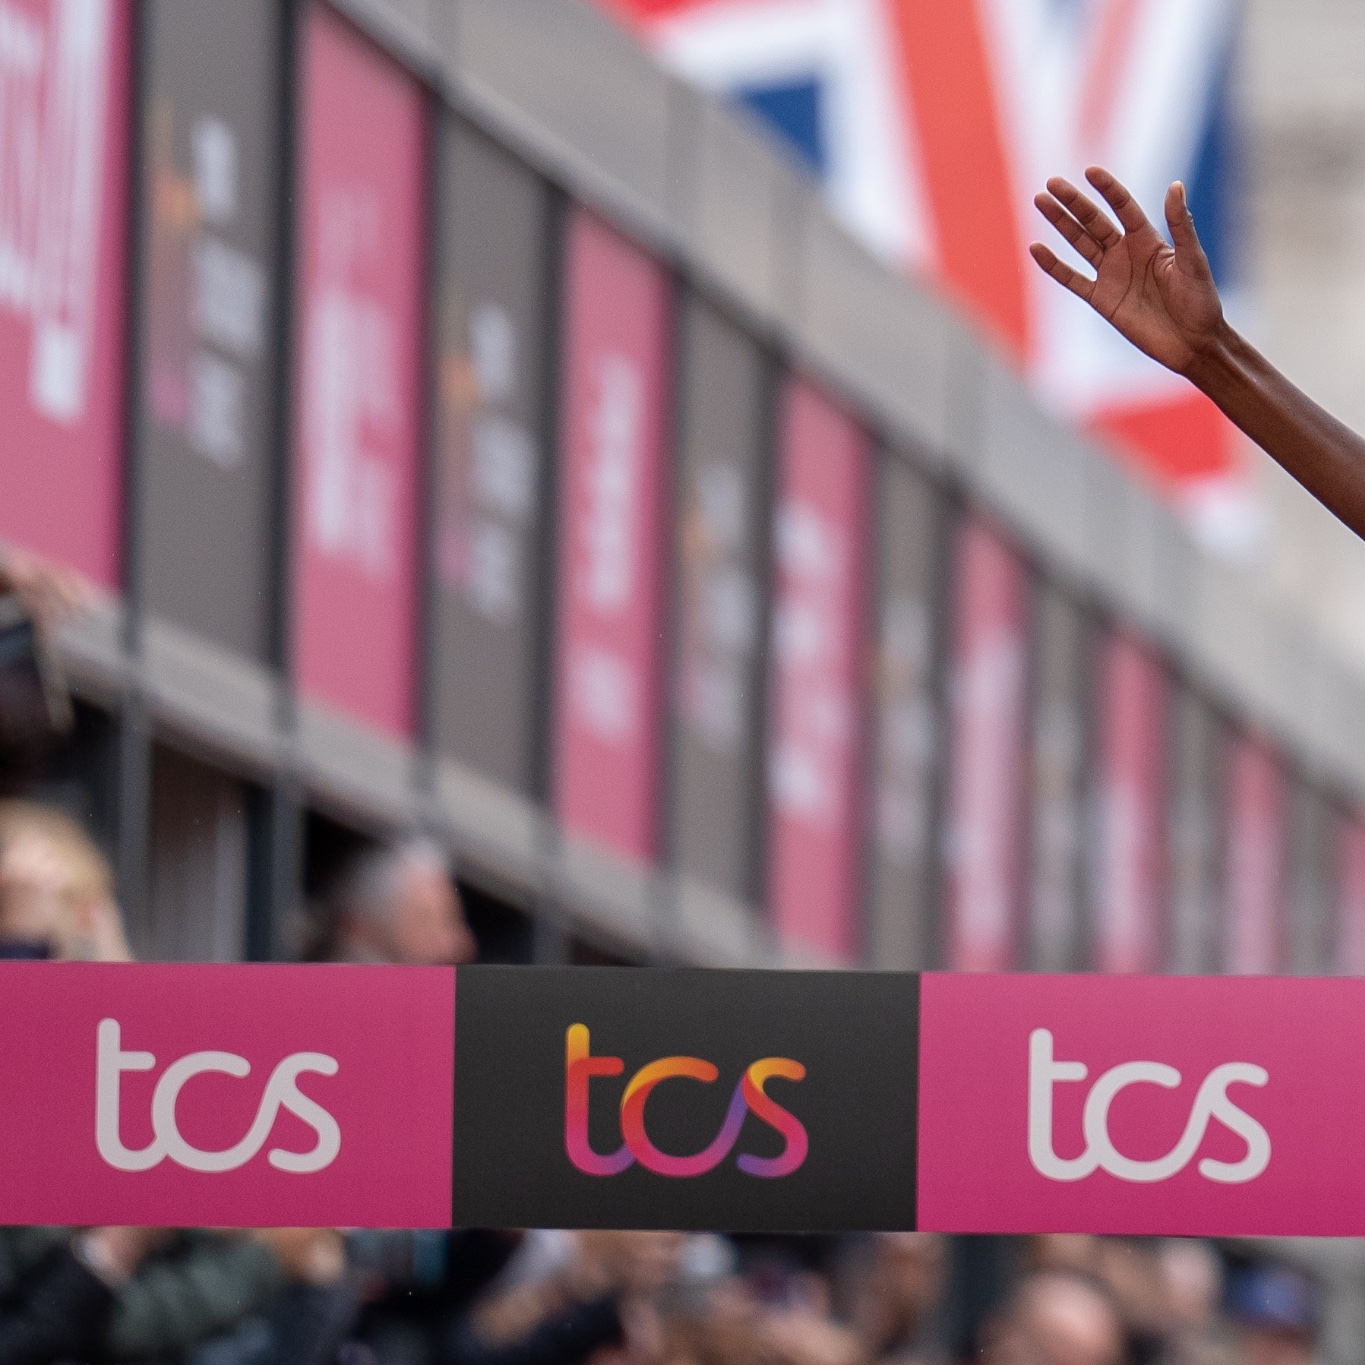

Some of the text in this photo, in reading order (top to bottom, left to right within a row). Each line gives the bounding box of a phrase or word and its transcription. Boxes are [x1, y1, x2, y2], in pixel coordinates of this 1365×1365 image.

[95, 1018, 342, 1173] tcs
[564, 1022, 810, 1179] tcs
[1028, 1027, 1272, 1183] tcs
